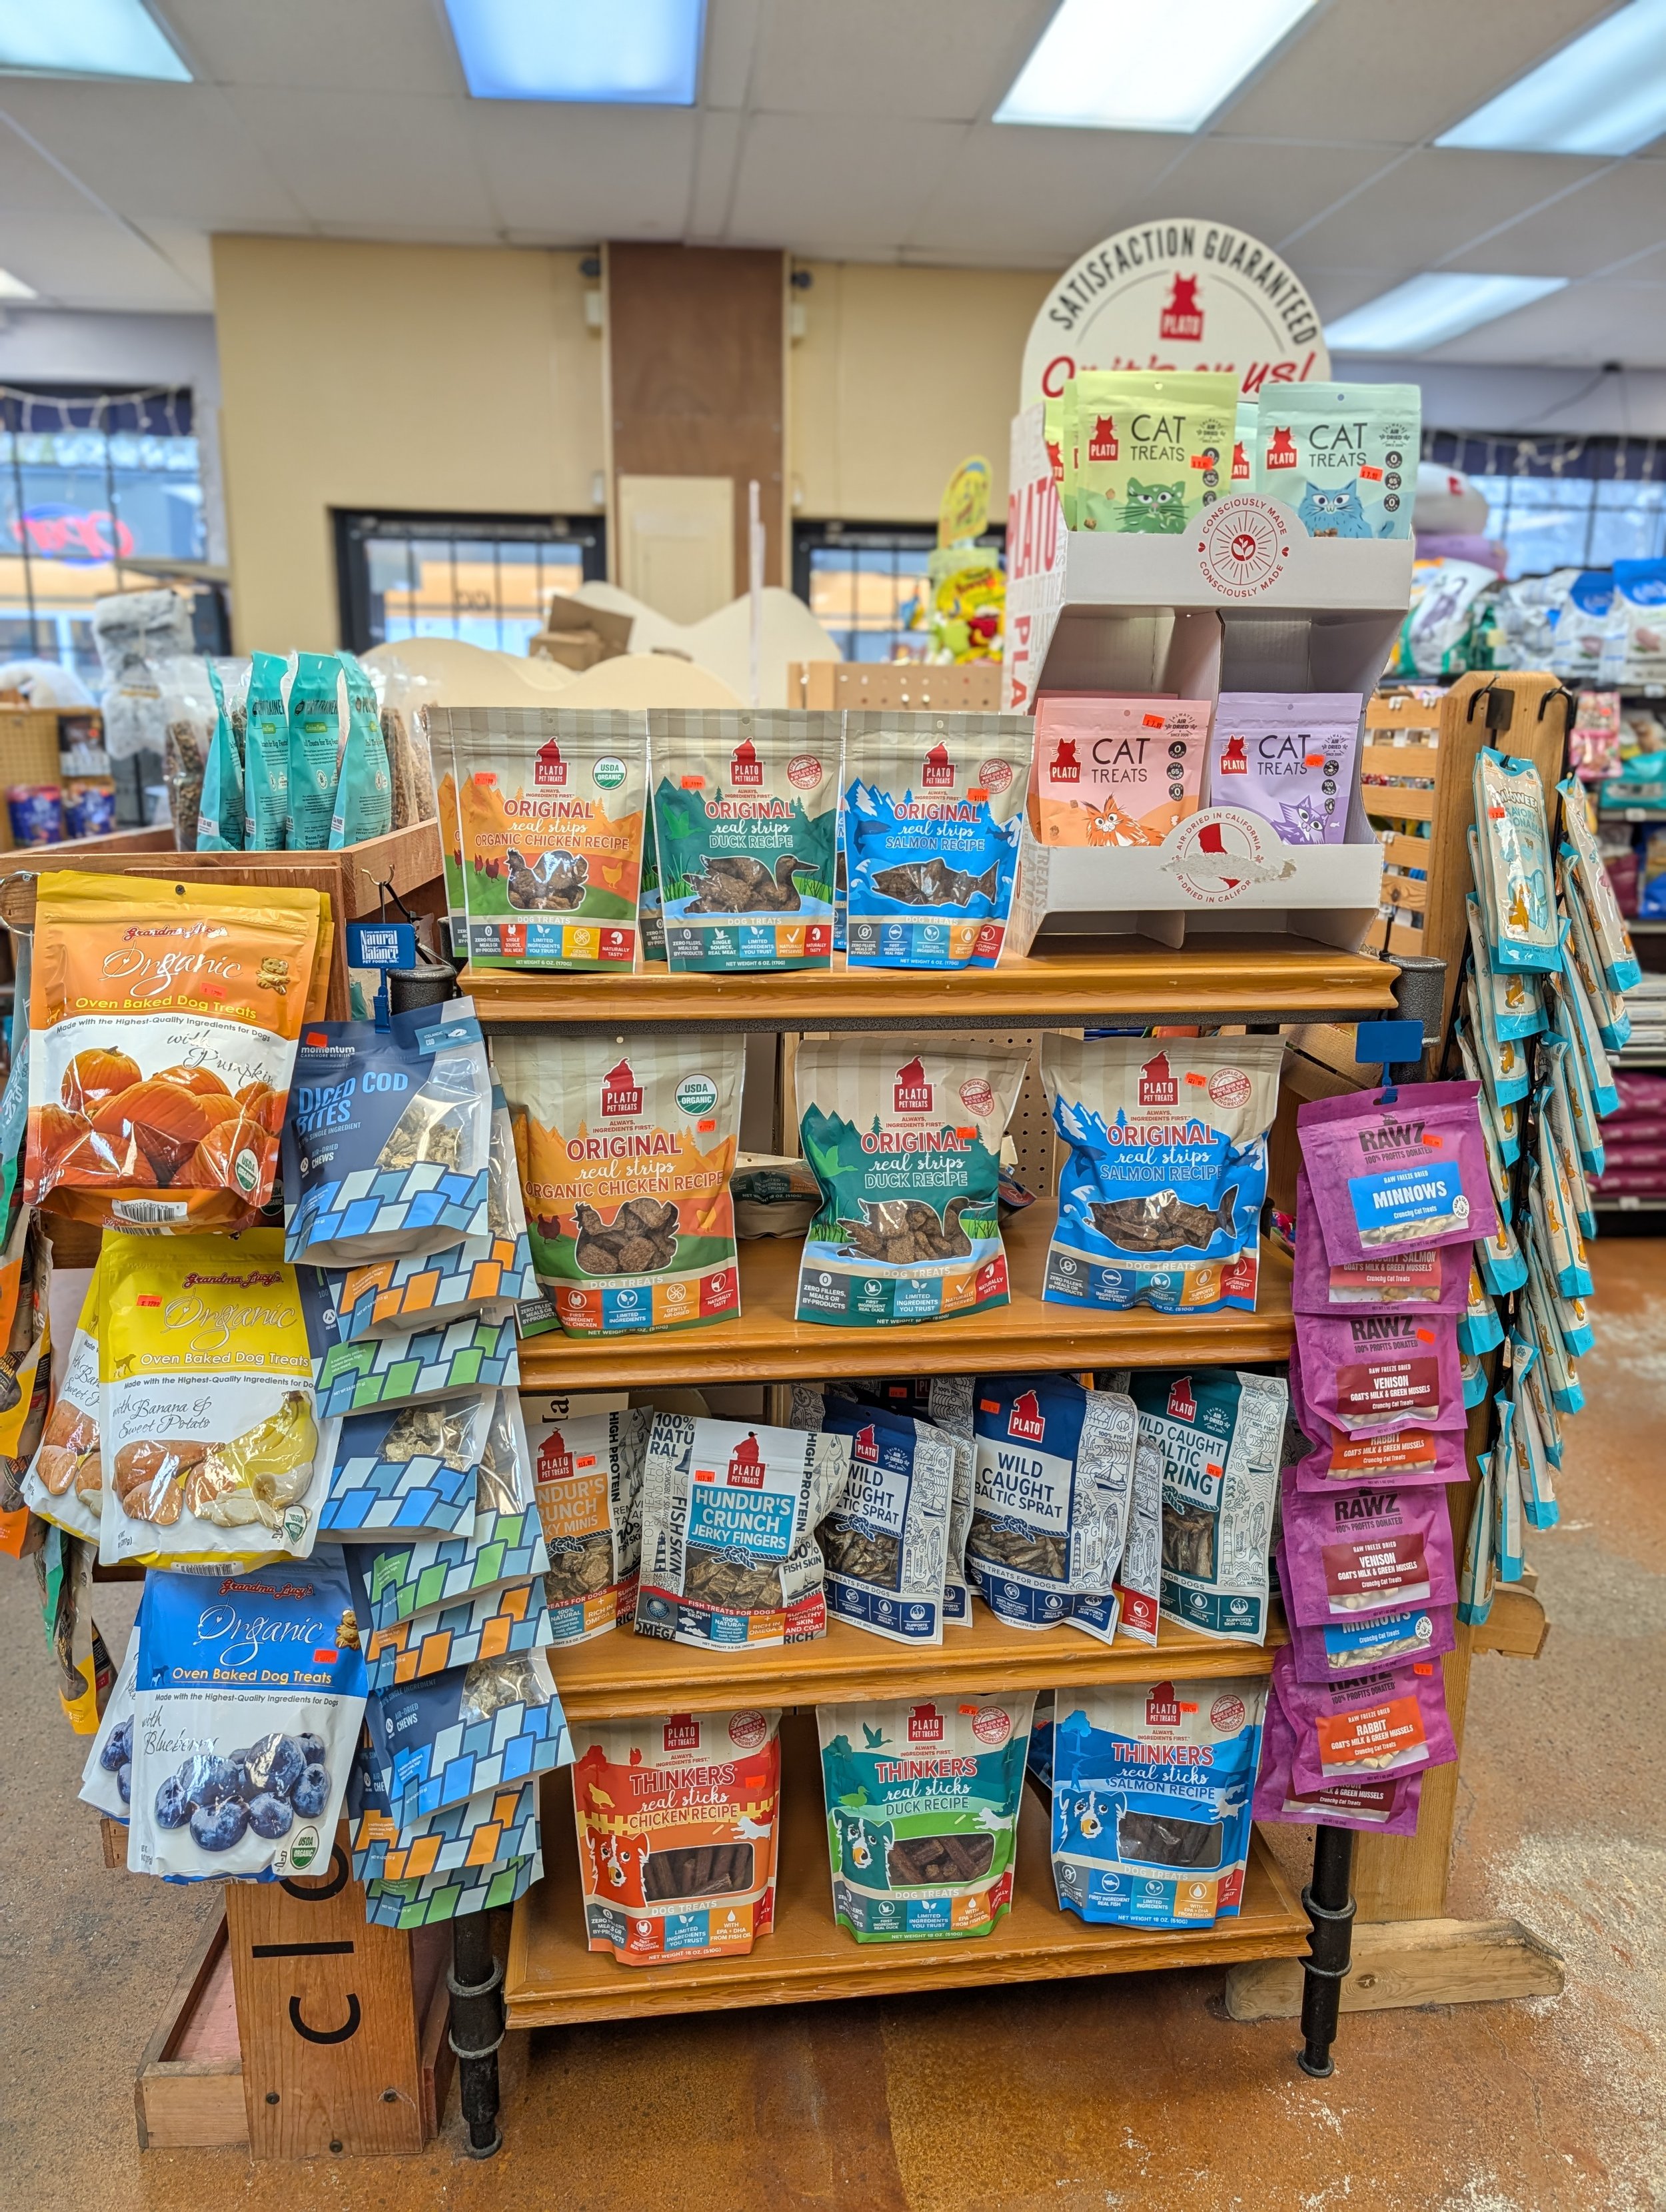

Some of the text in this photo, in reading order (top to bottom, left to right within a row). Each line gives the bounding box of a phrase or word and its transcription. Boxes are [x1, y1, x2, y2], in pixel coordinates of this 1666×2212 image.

[1049, 225, 1318, 346] SATISFACTION GUARANTEED
[1162, 314, 1202, 336] PLATO
[1132, 414, 1186, 444] CAT
[1309, 422, 1367, 450] CAT
[1091, 444, 1116, 456] PLATO
[1130, 446, 1185, 461] TREATS
[1269, 453, 1294, 464] PLATO
[1309, 452, 1366, 467] TREATS
[1203, 498, 1287, 535] CONSCIOUSLY MADE
[1200, 562, 1283, 598] CONSCIOUSLY MADE
[1092, 737, 1151, 765] CAT
[1258, 734, 1311, 759] CAT
[539, 765, 563, 776] PLATO
[600, 764, 619, 772] USDA
[734, 765, 758, 776] PLATO
[926, 767, 950, 778] PLATO
[1052, 766, 1079, 779] PLATO
[1223, 760, 1245, 770] PLATO
[1257, 762, 1307, 776] TREATS
[1091, 768, 1148, 784] TREATS
[504, 800, 595, 820] ORIGINAL
[705, 801, 796, 820] ORIGINAL
[894, 803, 981, 823] ORIGINAL
[507, 818, 588, 833] real strips
[1176, 815, 1210, 851] AIR-DRIED
[1225, 813, 1261, 851] CALIFORNIA
[475, 833, 629, 851] ORGANIC CHICKEN RECIPE
[709, 835, 794, 849] DUCK RECIPE
[886, 836, 985, 851] SALMON RECIPE
[360, 930, 398, 945] Natural
[362, 945, 399, 959] Balance
[98, 941, 244, 997] Organic
[75, 995, 257, 1020] Oven Baked Dog Treats
[115, 1016, 237, 1033] Highest-Quality Ingredients
[301, 1045, 355, 1055] momentum
[362, 1071, 409, 1094] COD
[684, 1083, 708, 1093] USDA
[1144, 1082, 1173, 1094] PLATO
[607, 1091, 638, 1103] PLATO
[681, 1095, 712, 1104] ORGANIC
[898, 1088, 928, 1099] PLATO
[860, 1131, 972, 1154] ORIGINAL
[1106, 1124, 1218, 1147] ORIGINAL
[566, 1133, 683, 1163] ORIGINAL
[311, 1151, 335, 1169] CHEWS
[574, 1155, 677, 1181] real strips
[868, 1153, 966, 1173] real strips
[864, 1172, 968, 1189] DUCK RECIPE
[1100, 1165, 1166, 1181] SALMON
[525, 1171, 724, 1199] ORGANIC CHICKEN RECIPE
[1372, 1181, 1447, 1209] MINNOWS
[182, 1271, 283, 1289] Grandma Lucy's
[808, 1292, 828, 1301] MEALS
[820, 1288, 846, 1298] FILLERS,
[802, 1297, 846, 1310] BY-PRODUCTS
[161, 1289, 299, 1352] Organic
[1350, 1317, 1415, 1341] RAWZ
[1354, 1340, 1418, 1354] 100% PROFITS DONATED
[140, 1352, 310, 1368] Oven Baked Dog Treats
[1373, 1375, 1409, 1390] VENISON
[1390, 1385, 1431, 1397] GREEN MUSSELS
[131, 1397, 188, 1419] Banana
[1170, 1400, 1194, 1416] PLATO
[118, 1414, 211, 1439] Sweet Potato
[1012, 1417, 1041, 1435] PLATO
[857, 1443, 876, 1458] PLATO
[733, 1464, 760, 1477] PLATO
[998, 1452, 1043, 1479] WILD
[798, 1432, 818, 1532] HIGH PROTEIN
[982, 1467, 1054, 1503] CAUGHT
[696, 1489, 792, 1516] HUNDUR'S
[974, 1482, 1063, 1518] BALTIC SPRAT
[1334, 1494, 1400, 1522] RAWZ
[702, 1509, 780, 1534] CRUNCH
[691, 1525, 786, 1550] JERKY FINGERS
[218, 1578, 314, 1601] Grandma Lucy's
[688, 1600, 705, 1609] FISH
[706, 1603, 734, 1614] TREATS
[193, 1596, 324, 1666] Organic
[172, 1667, 332, 1684] Oven Baked Dog Treats
[1360, 1711, 1377, 1720] FREEZE
[1356, 1719, 1387, 1736] RABBIT
[1111, 1742, 1214, 1766] THINKERS
[875, 1757, 978, 1783] THINKERS
[1116, 1764, 1209, 1786] real sticks
[629, 1764, 735, 1796] THINKERS
[1110, 1777, 1216, 1800] SALMON RECIPE
[885, 1797, 969, 1817] DUCK RECIPE
[629, 1804, 738, 1830] CHICKEN RECIPE
[297, 1836, 313, 1846] USDA
